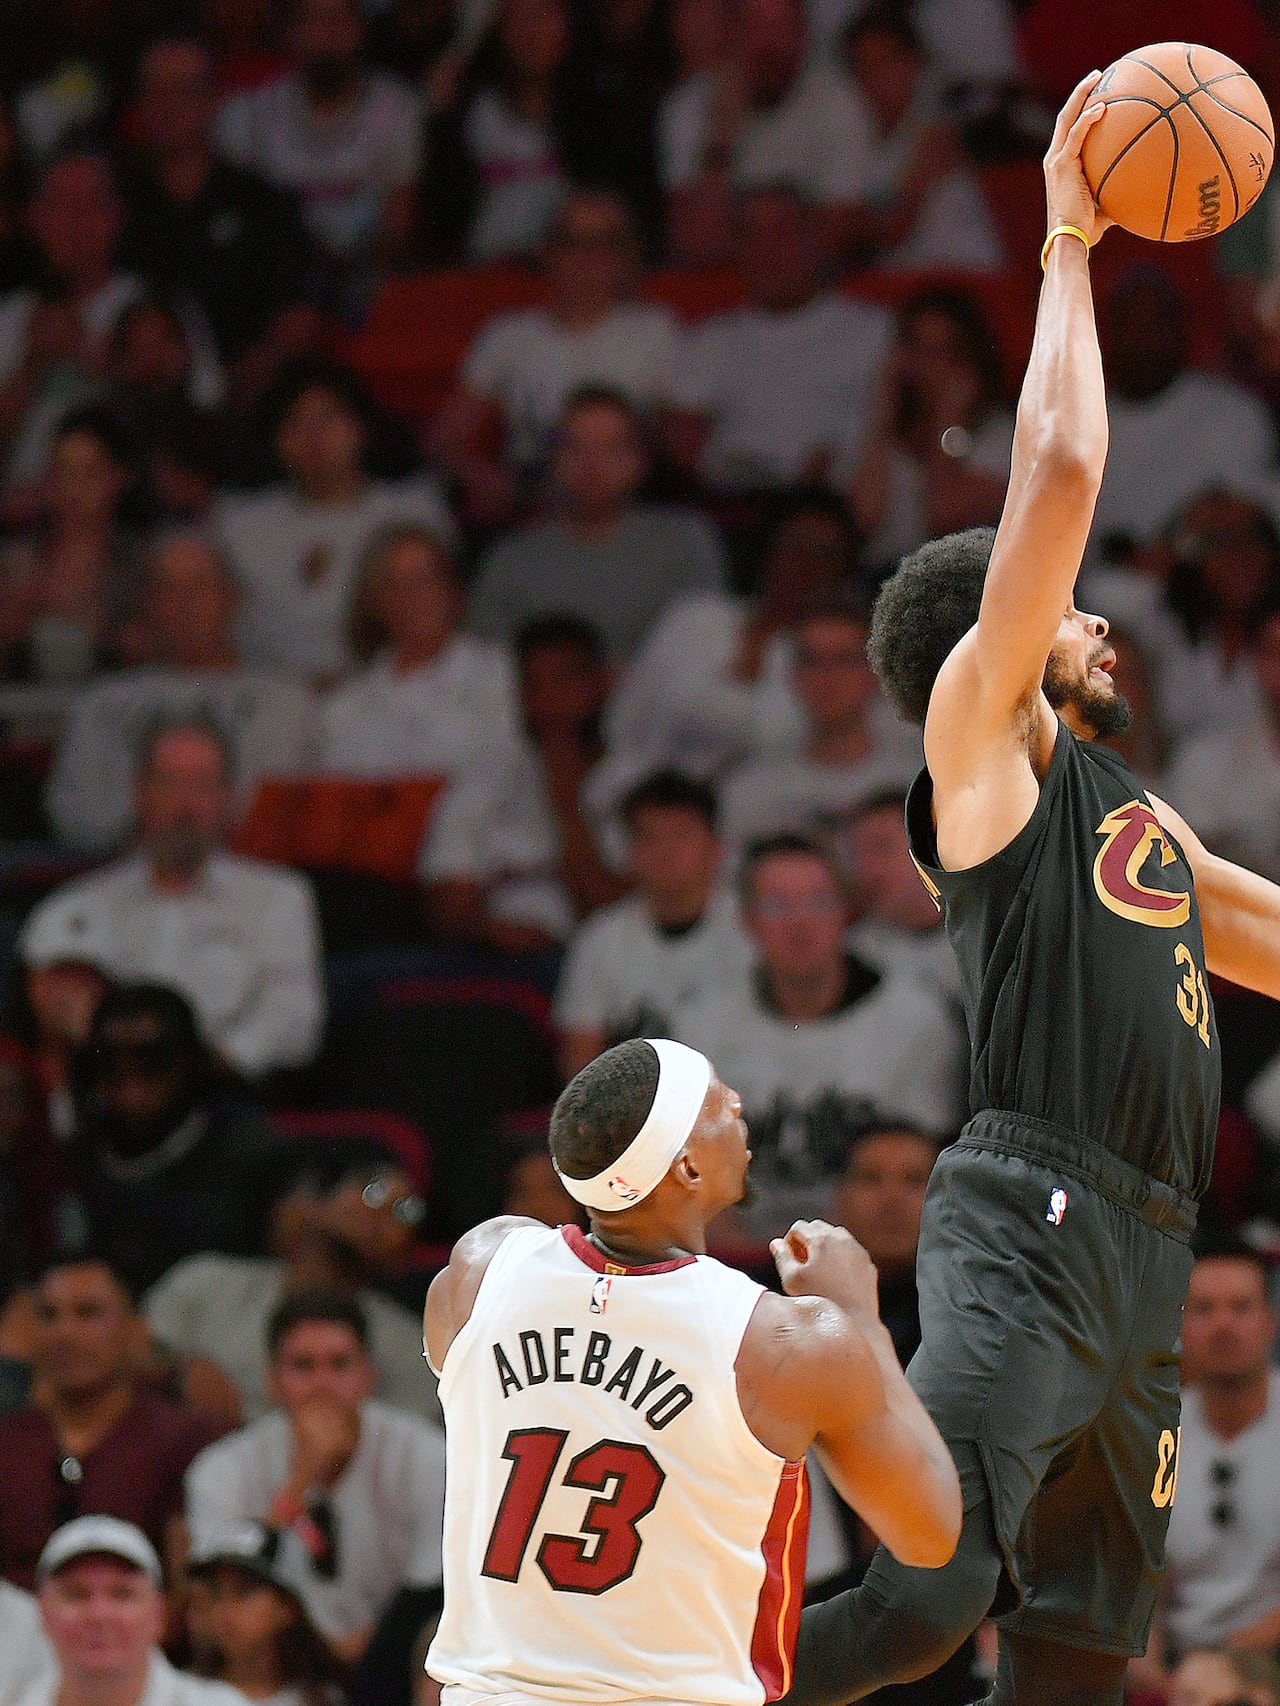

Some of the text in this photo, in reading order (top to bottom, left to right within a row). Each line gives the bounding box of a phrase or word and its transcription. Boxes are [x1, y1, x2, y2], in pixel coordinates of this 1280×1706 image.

[1174, 942, 1211, 1050] 31
[493, 1327, 693, 1431] ADEBAYO
[480, 1426, 666, 1596] 13
